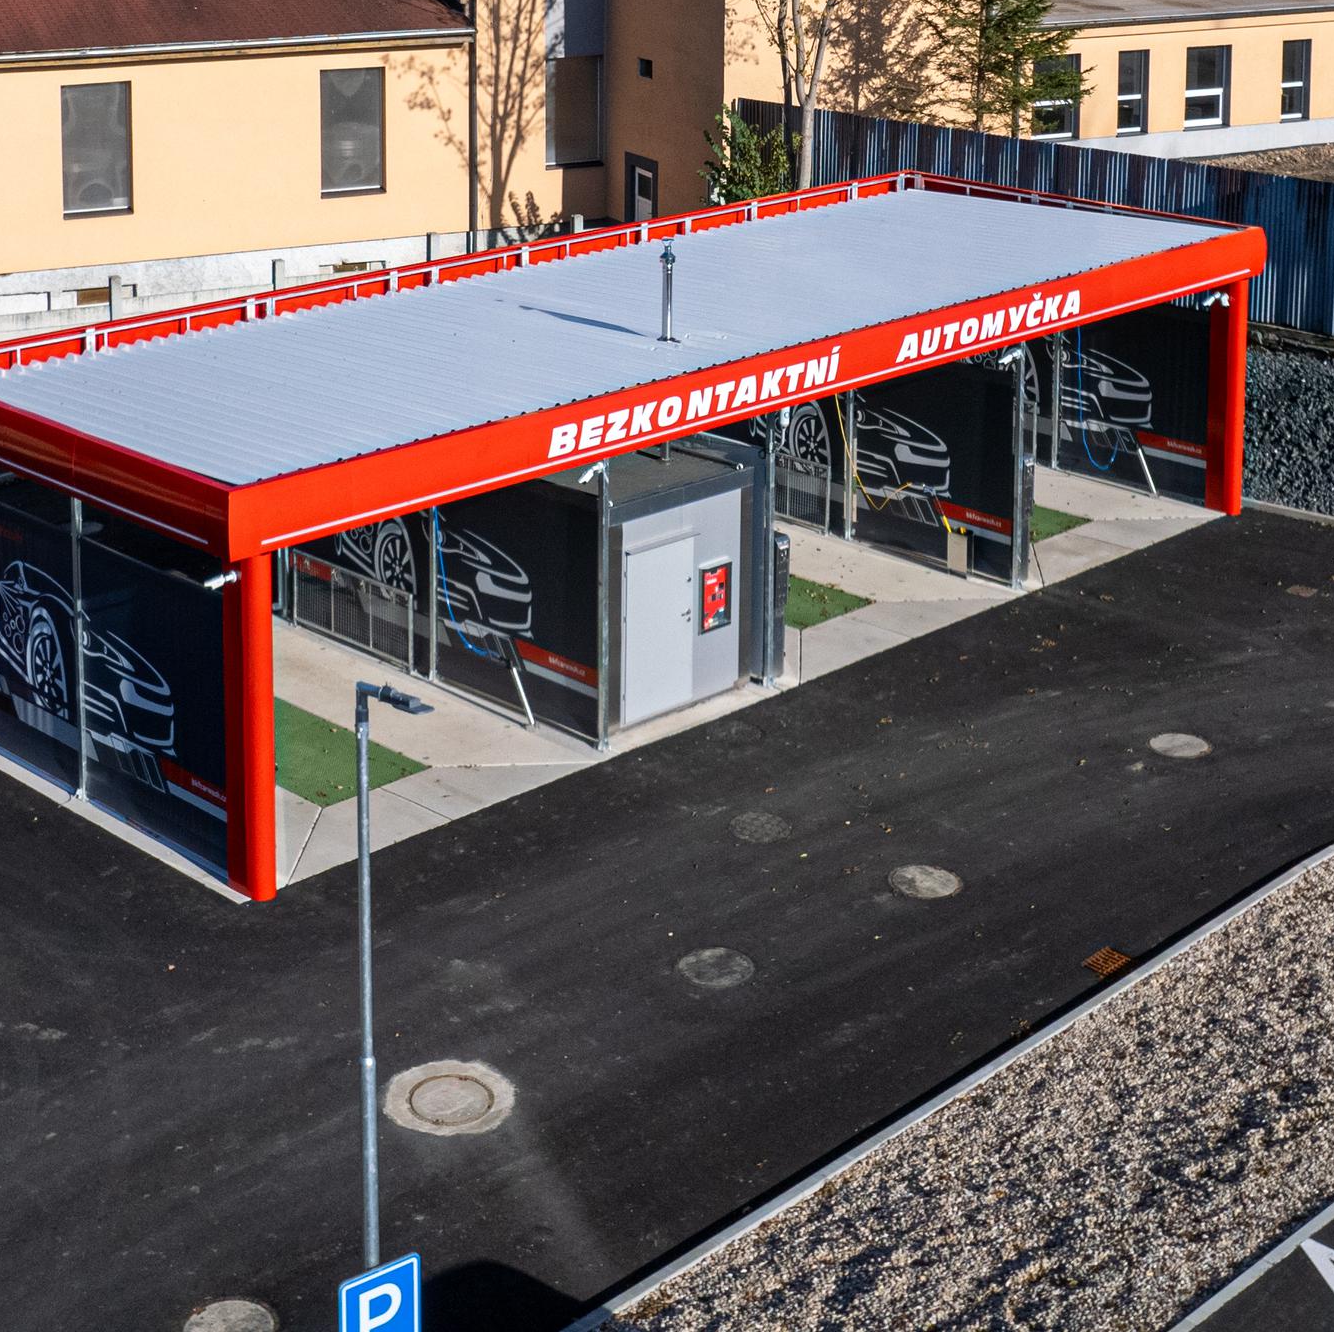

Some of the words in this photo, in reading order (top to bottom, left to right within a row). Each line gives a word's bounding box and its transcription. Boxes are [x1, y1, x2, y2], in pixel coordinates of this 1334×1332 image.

[548, 346, 841, 459] BEZKONTAKTNÍ
[895, 289, 1081, 363] AUTOMYČKA
[359, 1282, 402, 1332] P
